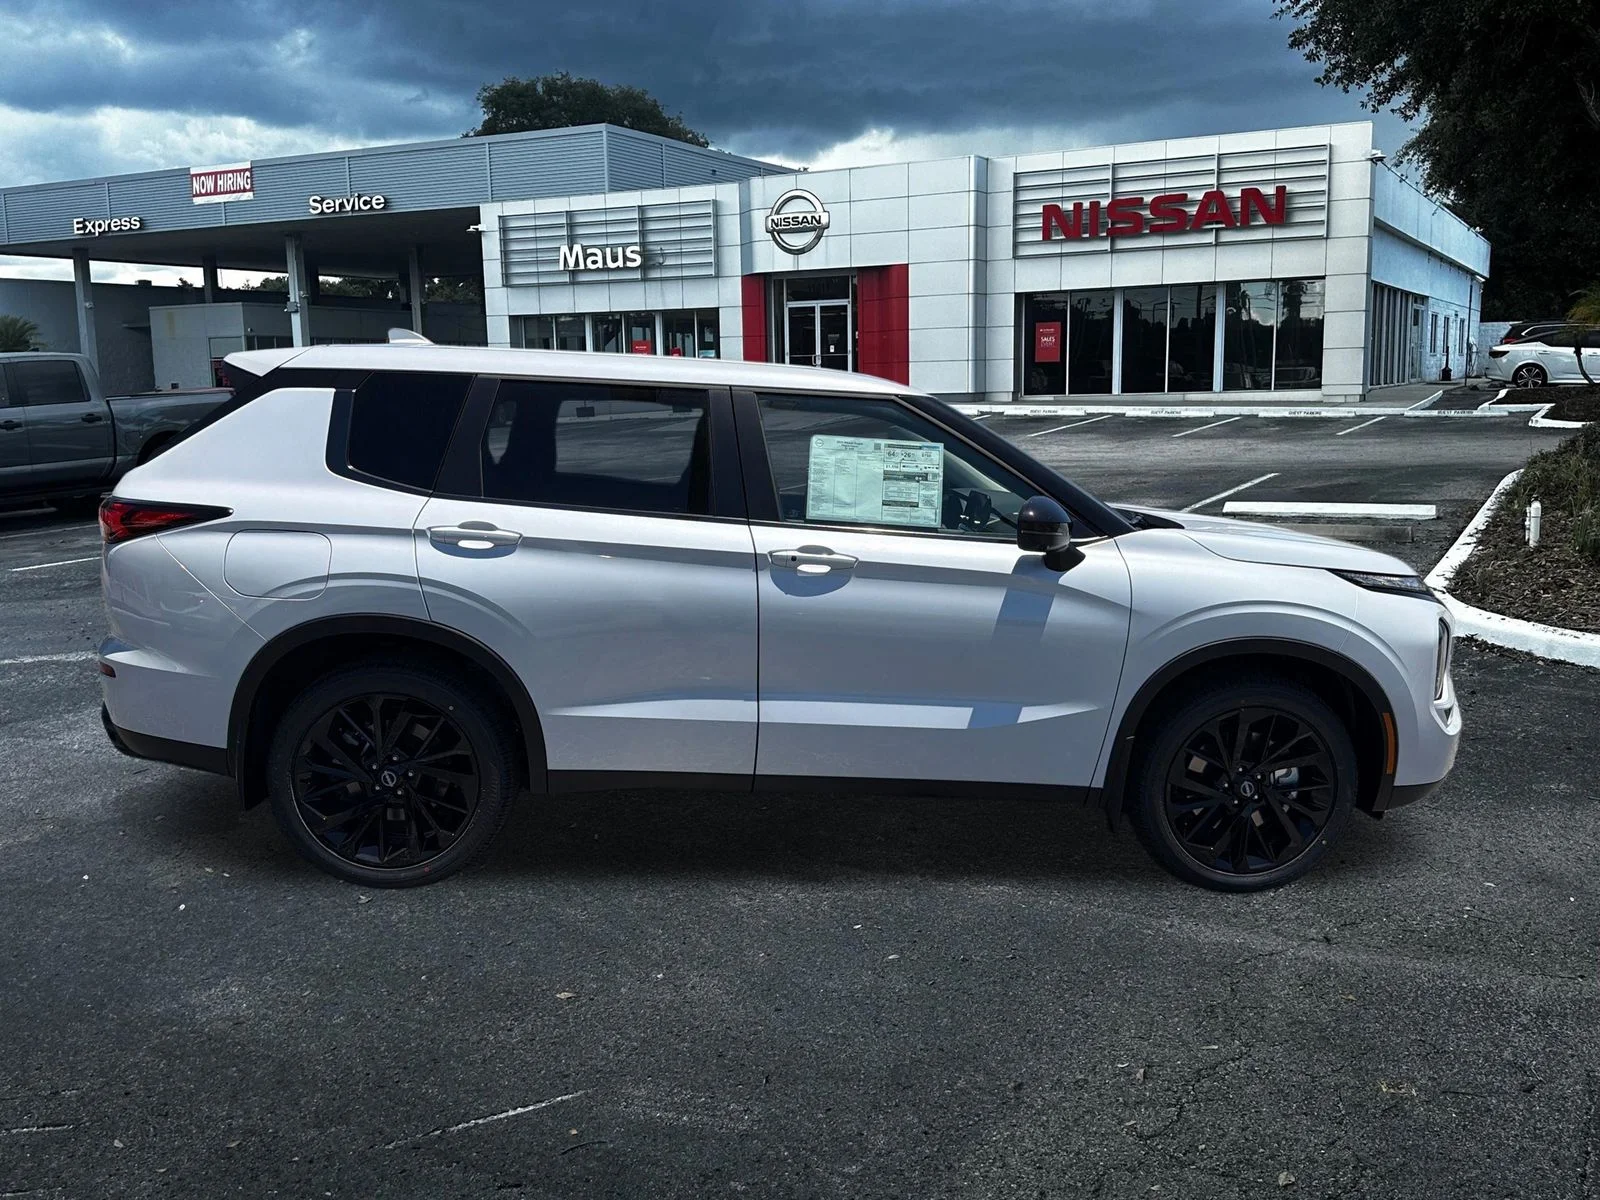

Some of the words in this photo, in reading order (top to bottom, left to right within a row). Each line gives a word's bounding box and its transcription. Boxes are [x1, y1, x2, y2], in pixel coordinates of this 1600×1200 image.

[192, 176, 214, 195] NOW
[217, 169, 251, 191] HIRING
[309, 193, 386, 215] Service
[1042, 185, 1287, 241] NISSAN
[73, 216, 141, 236] Express
[770, 214, 822, 228] NISSAN
[559, 244, 642, 271] Maus
